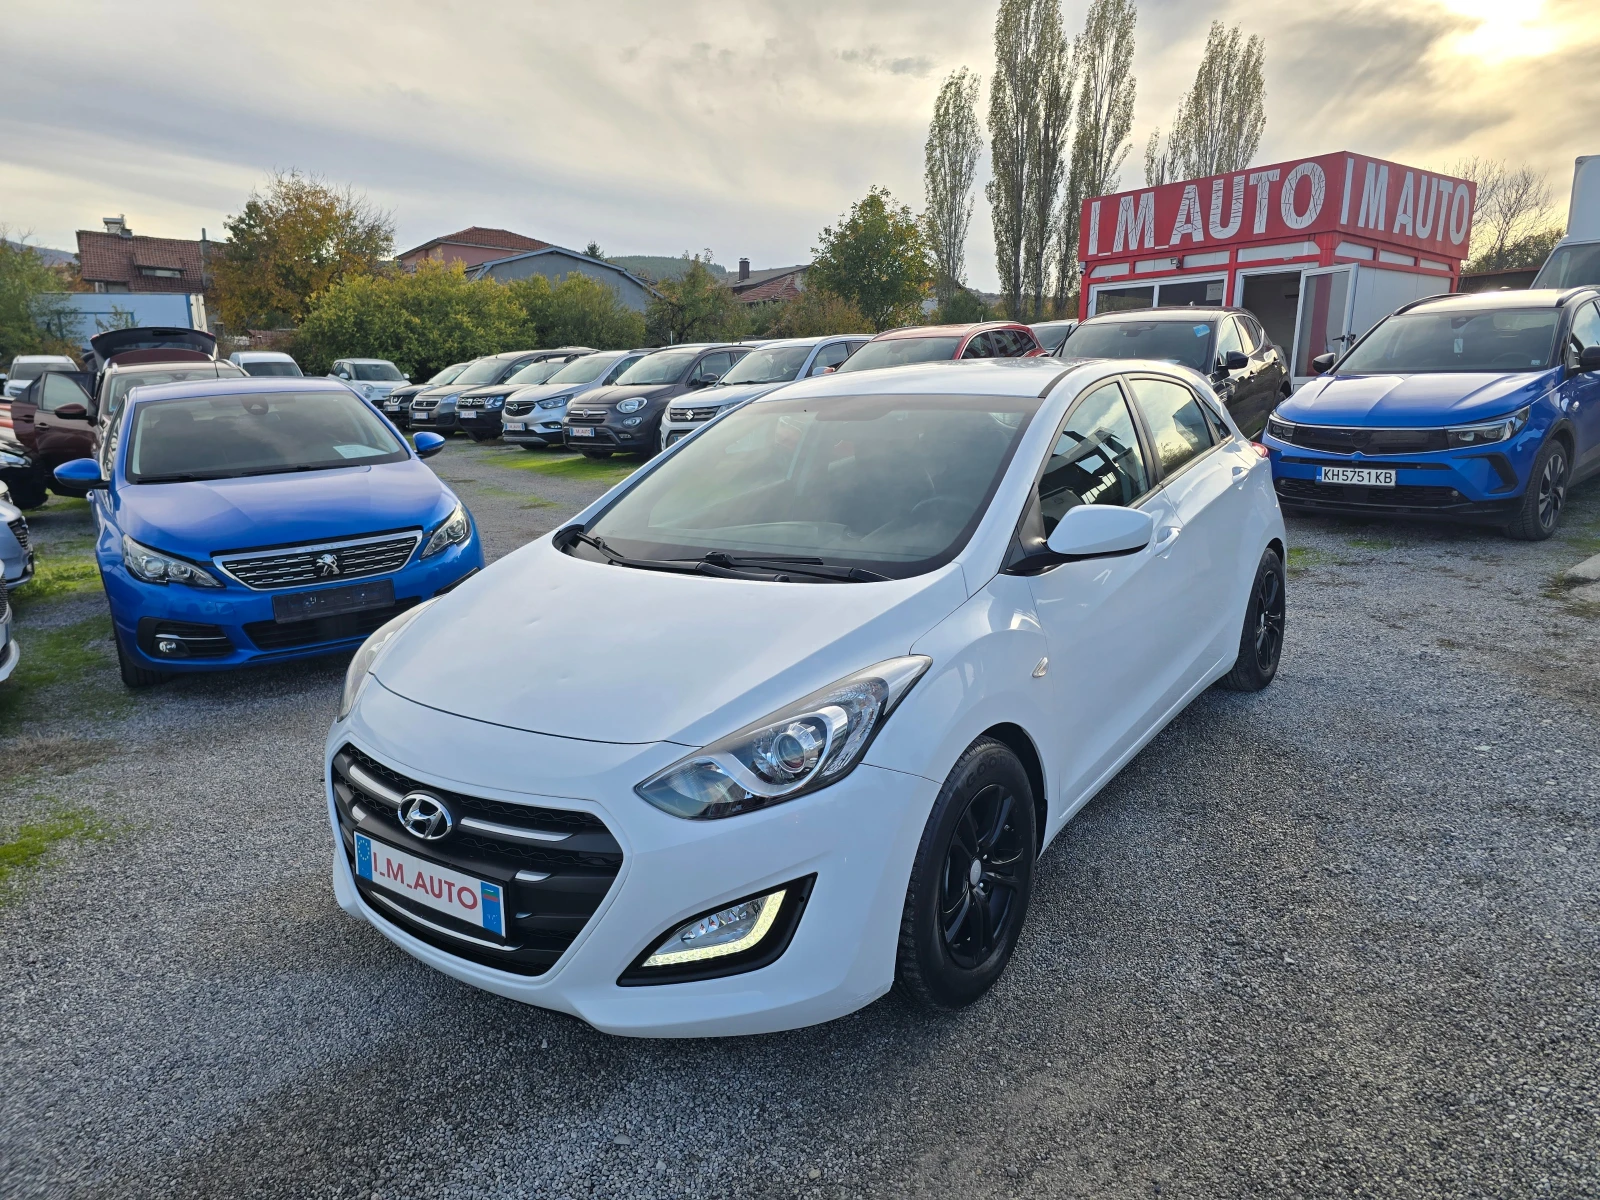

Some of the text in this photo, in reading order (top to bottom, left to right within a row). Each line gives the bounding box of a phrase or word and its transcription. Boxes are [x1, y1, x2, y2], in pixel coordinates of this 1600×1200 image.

[1340, 158, 1470, 245] I M AUTO
